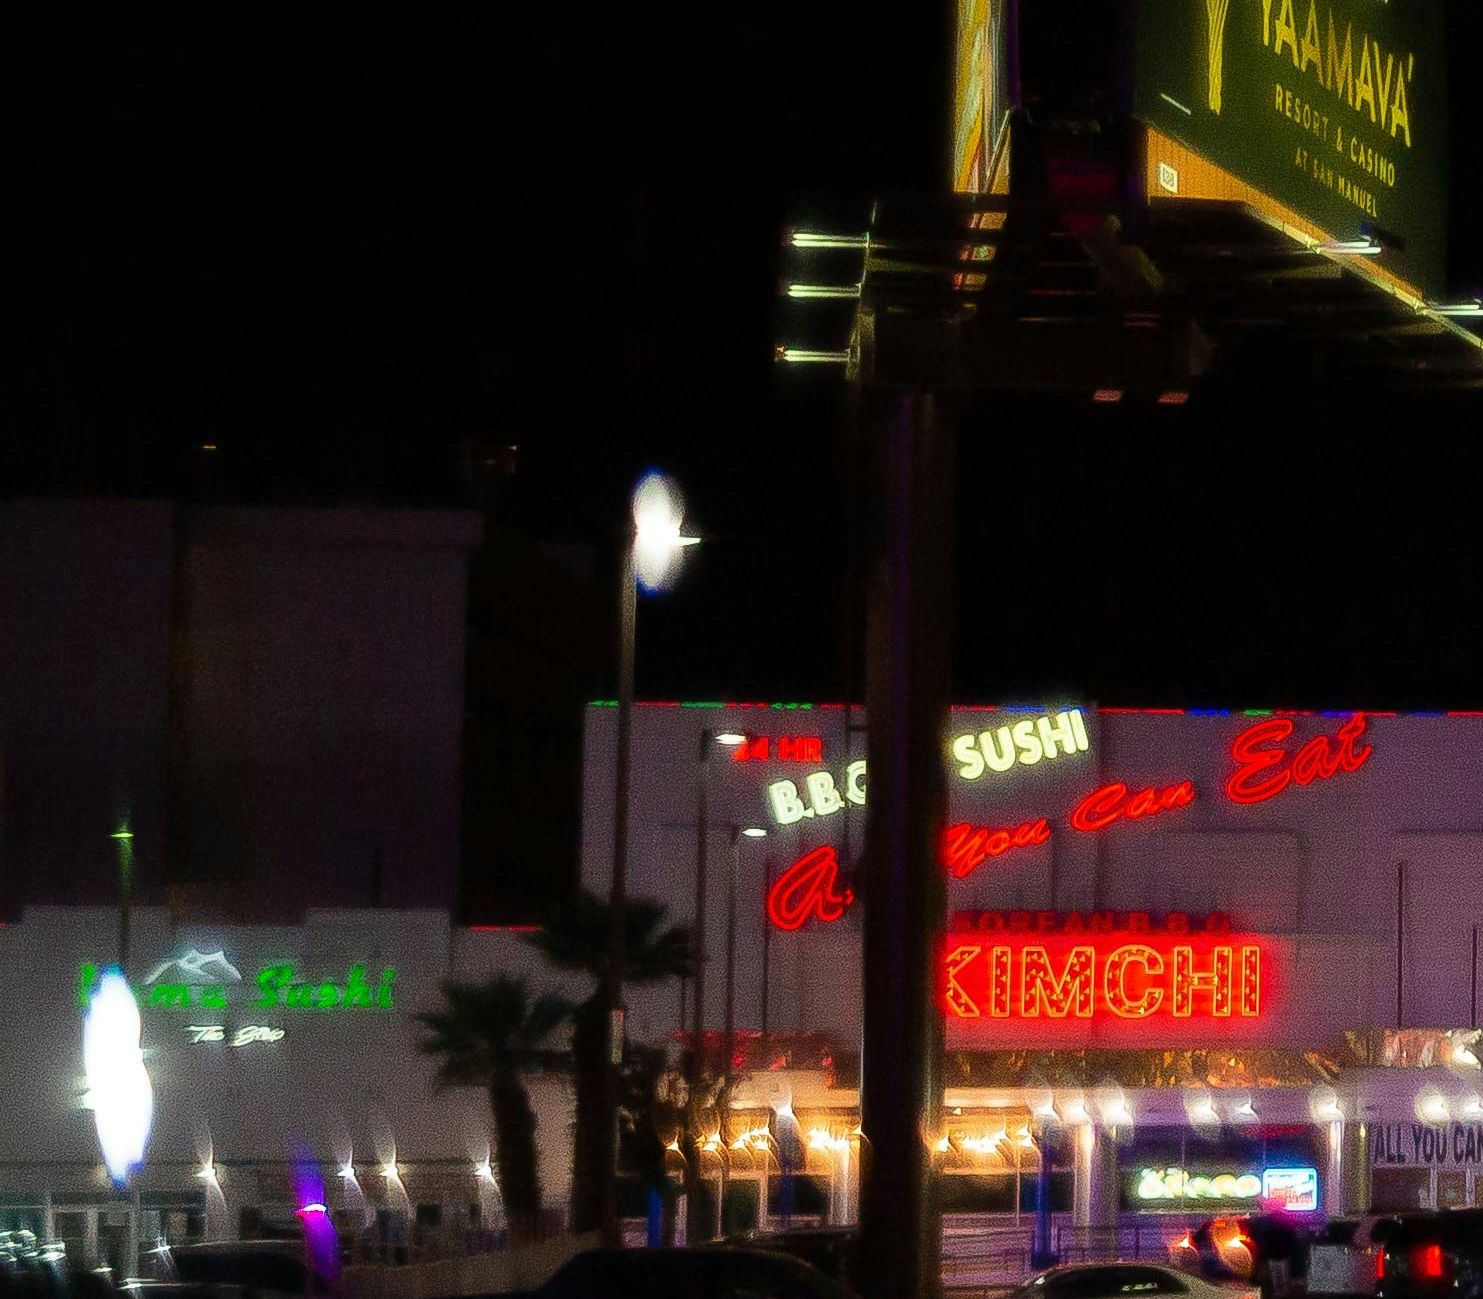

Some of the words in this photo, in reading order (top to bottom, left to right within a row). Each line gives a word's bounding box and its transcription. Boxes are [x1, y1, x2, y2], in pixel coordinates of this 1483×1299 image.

[1275, 83, 1328, 142] RESORT
[1336, 125, 1343, 152] &
[1350, 137, 1395, 187] CASINO
[1338, 175, 1378, 218] MANUEL
[778, 736, 823, 763] HR
[952, 708, 1090, 780] SUSHI
[1226, 710, 1372, 805] Eat
[256, 962, 397, 1009] Sushi
[944, 945, 1261, 1019] KIMCHI
[1374, 1124, 1406, 1165] ALL
[1412, 1123, 1447, 1165] YOU
